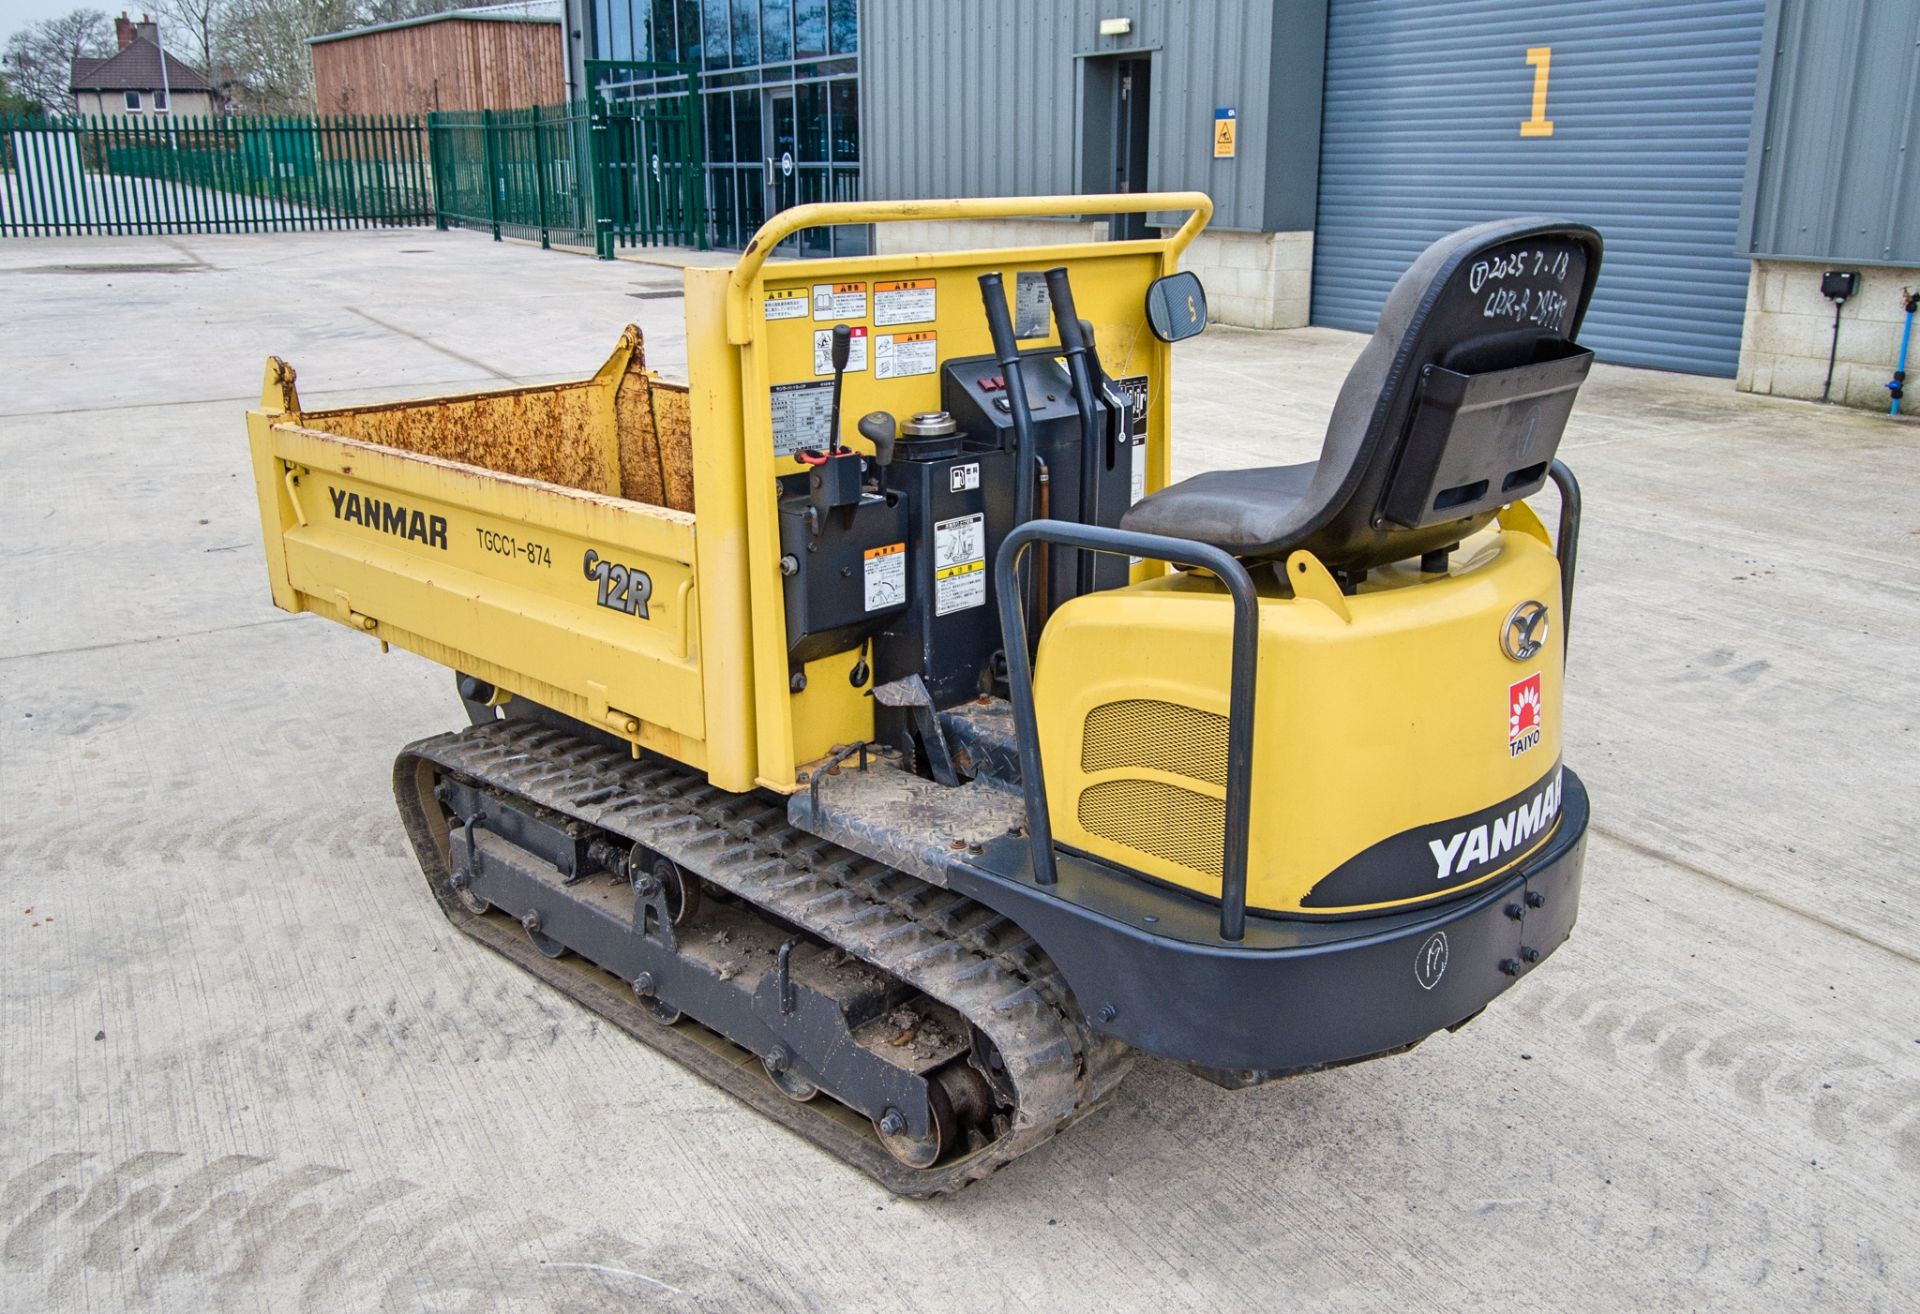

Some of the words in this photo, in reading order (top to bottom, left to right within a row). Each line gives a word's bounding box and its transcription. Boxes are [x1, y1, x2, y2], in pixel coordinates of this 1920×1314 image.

[1520, 47, 1554, 137] 1
[1489, 251, 1528, 279] 2025
[328, 486, 448, 550] YANMAR
[476, 528, 552, 568] TGCC1-874
[583, 548, 653, 620] C12R
[1509, 729, 1540, 757] TAIYO
